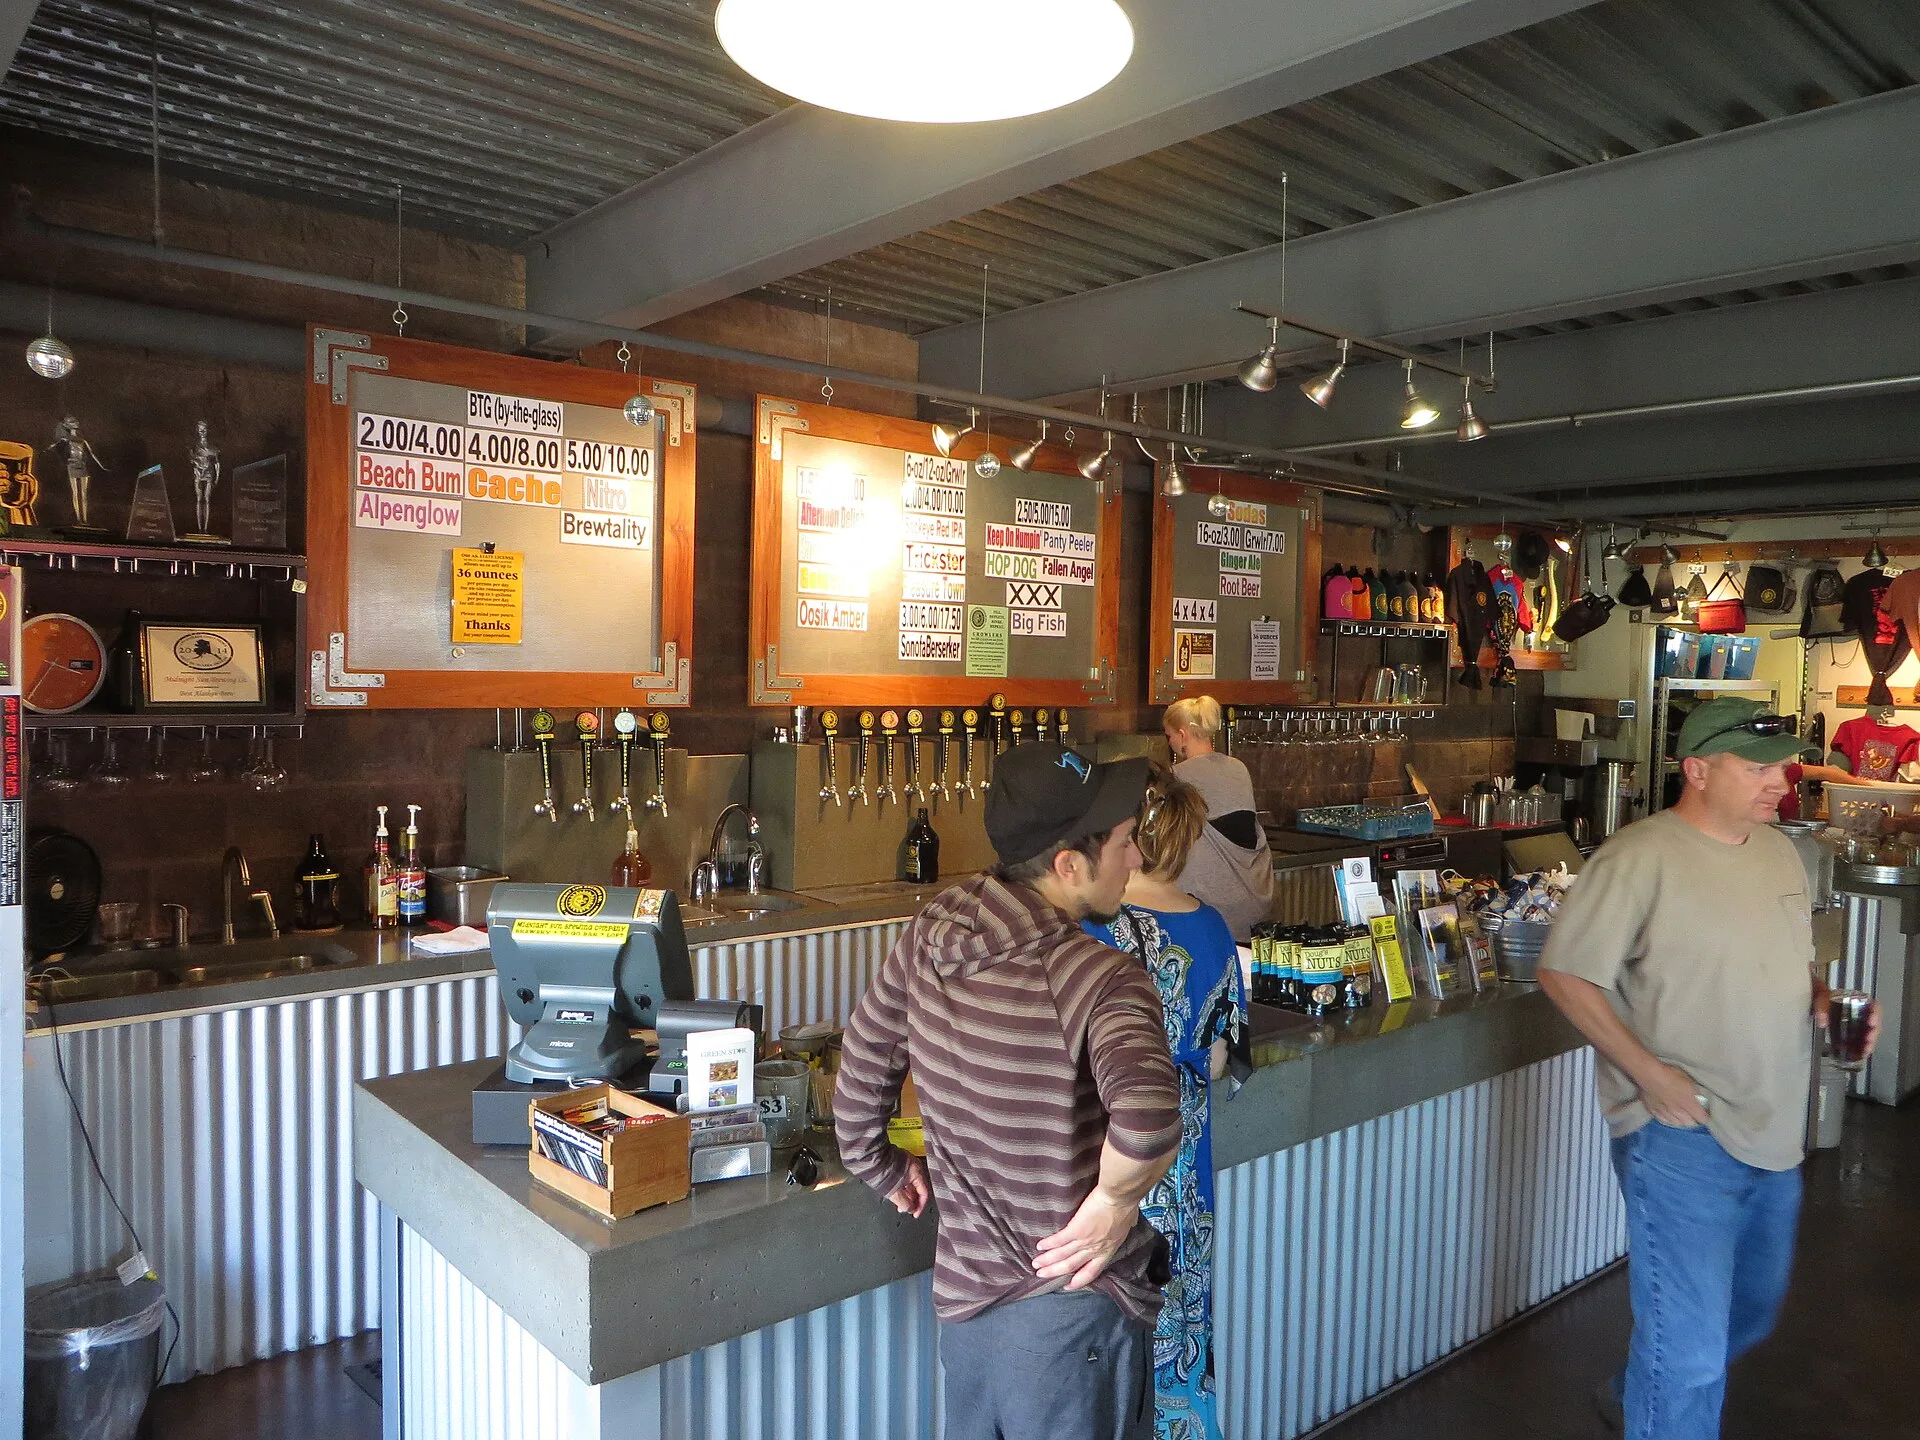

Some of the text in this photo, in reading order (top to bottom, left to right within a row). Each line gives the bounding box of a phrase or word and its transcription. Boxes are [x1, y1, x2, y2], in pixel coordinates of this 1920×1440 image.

[469, 392, 562, 433] BTG (by-the-glass)
[360, 416, 461, 458] 2.00/4.00
[468, 432, 559, 469] 4.00/8.00
[567, 440, 650, 477] 5.00/10.00
[360, 455, 461, 494] Beach Bum
[468, 467, 561, 505] Cache
[586, 477, 627, 511] Nitro
[359, 492, 459, 530] Alpenglow
[1017, 500, 1070, 527] 2.50/5.00/15.00
[1228, 501, 1266, 525] Sodas
[563, 512, 647, 546] Brewtality
[936, 519, 950, 538] Red
[952, 521, 964, 540] IPA
[987, 525, 1004, 548] Keep
[1005, 526, 1014, 547] On
[1199, 523, 1284, 553] 16-oz/3.00 Grwlr/7.00
[1043, 531, 1094, 553] Panty Peeler
[906, 544, 965, 572] Trickster
[987, 553, 1037, 579] HOP DOG
[1042, 557, 1094, 583] Fallen Angel
[1220, 551, 1261, 571] Ginger Ale
[457, 568, 518, 580] 36 ounces
[943, 576, 965, 600] Town
[1009, 583, 1060, 606] XXX
[1220, 576, 1260, 597] Root Beer
[799, 600, 865, 629] Oosik Amber
[902, 604, 961, 630] 3.00/6.00/17.50
[1174, 599, 1215, 621] 4 x 4 x 4
[464, 619, 511, 631] Thanks
[1012, 612, 1033, 634] Big
[1038, 614, 1065, 632] Fish
[1304, 950, 1329, 959] Doug's
[1306, 956, 1341, 970] NUTS
[1344, 947, 1371, 962] NUTS
[549, 1040, 575, 1048] micros
[700, 1050, 727, 1058] GREEN
[760, 1098, 783, 1114] $3
